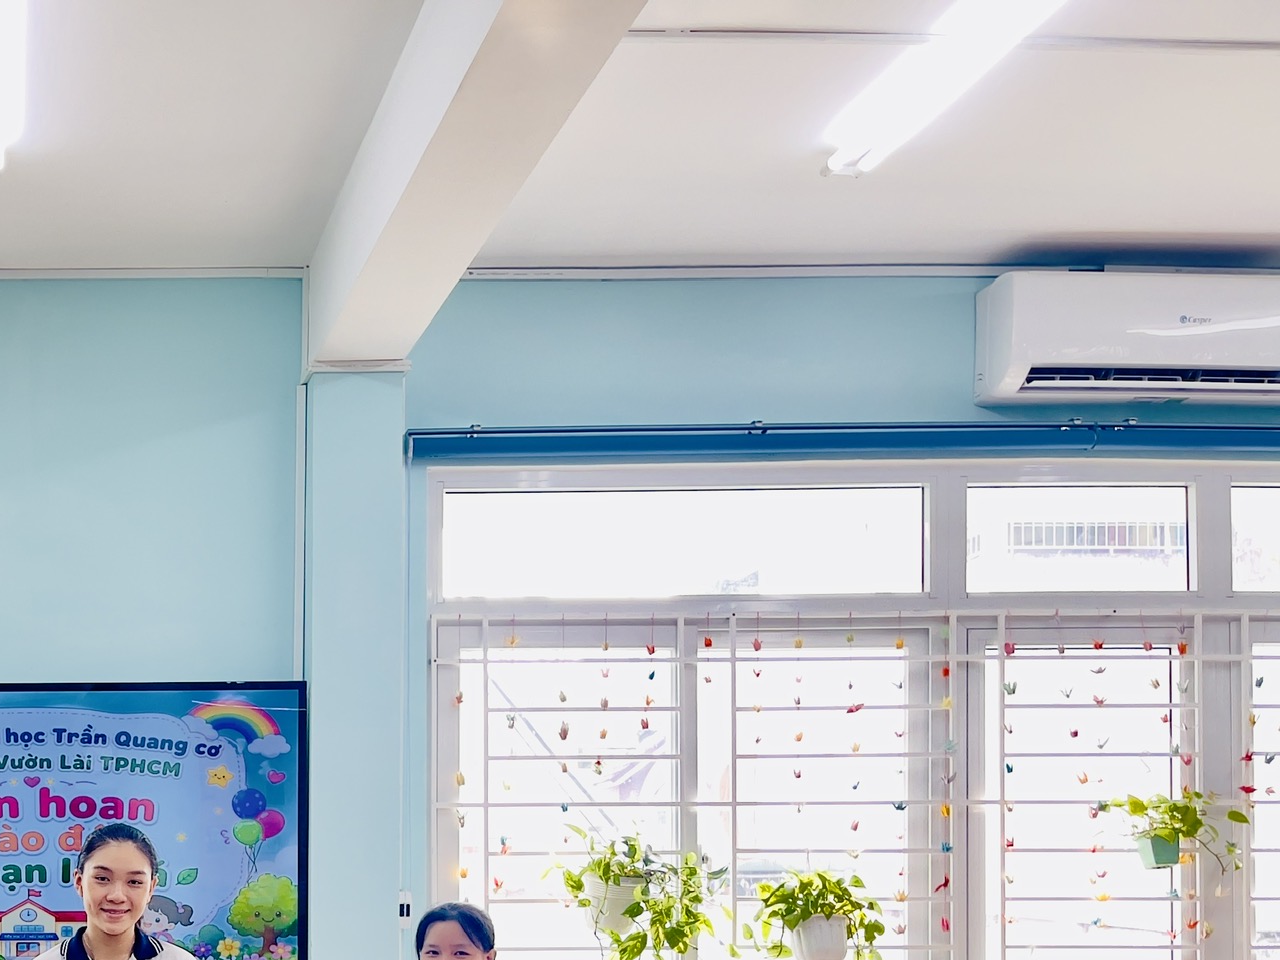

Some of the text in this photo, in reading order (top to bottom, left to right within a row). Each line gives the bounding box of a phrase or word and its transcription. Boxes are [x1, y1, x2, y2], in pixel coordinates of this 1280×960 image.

[5, 728, 46, 748] học
[53, 724, 107, 745] Trần
[114, 731, 188, 757] Quang
[60, 755, 92, 771] Lài
[100, 756, 181, 777] TPHCM
[39, 787, 155, 821] hoan
